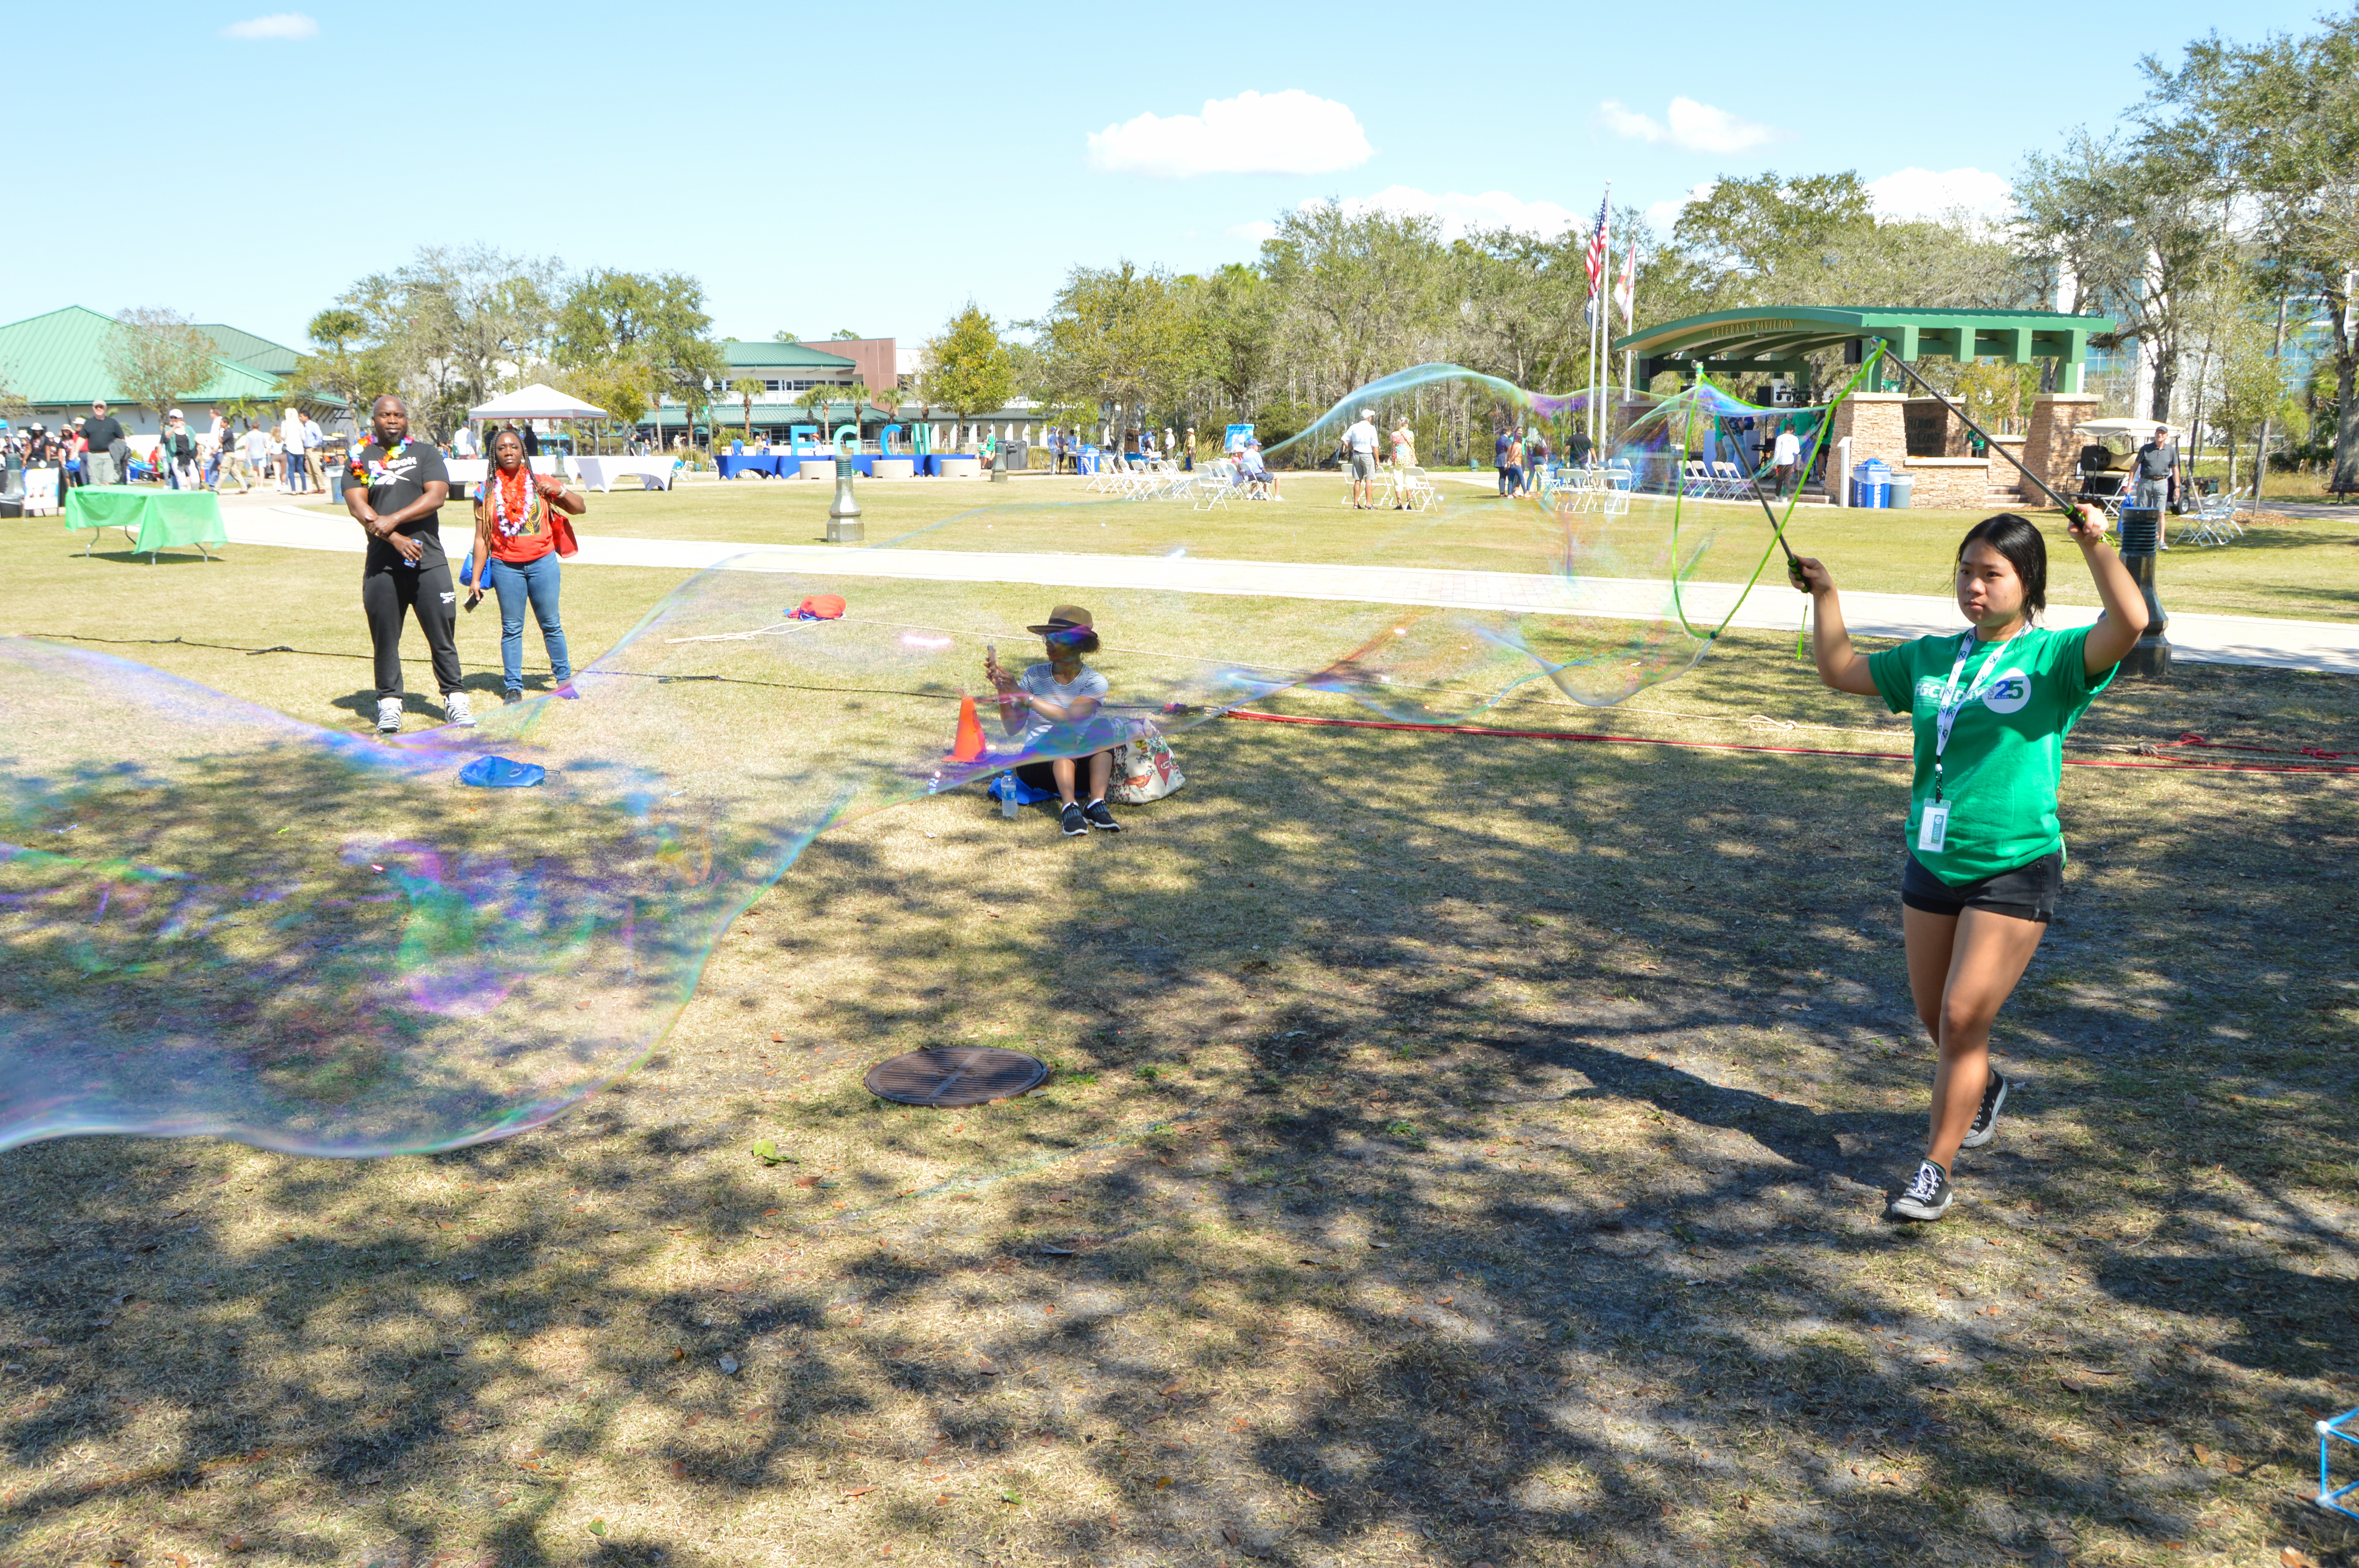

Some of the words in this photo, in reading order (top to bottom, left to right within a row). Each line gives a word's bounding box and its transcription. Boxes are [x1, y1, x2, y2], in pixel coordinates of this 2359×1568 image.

[1712, 322, 1751, 337] VETERANS
[1756, 319, 1794, 330] PAVILION
[368, 456, 417, 469] Rebok
[1958, 650, 1967, 659] 25
[1953, 689, 1986, 702] DAY
[1988, 683, 1996, 700] FGC
[1994, 681, 2024, 699] 25
